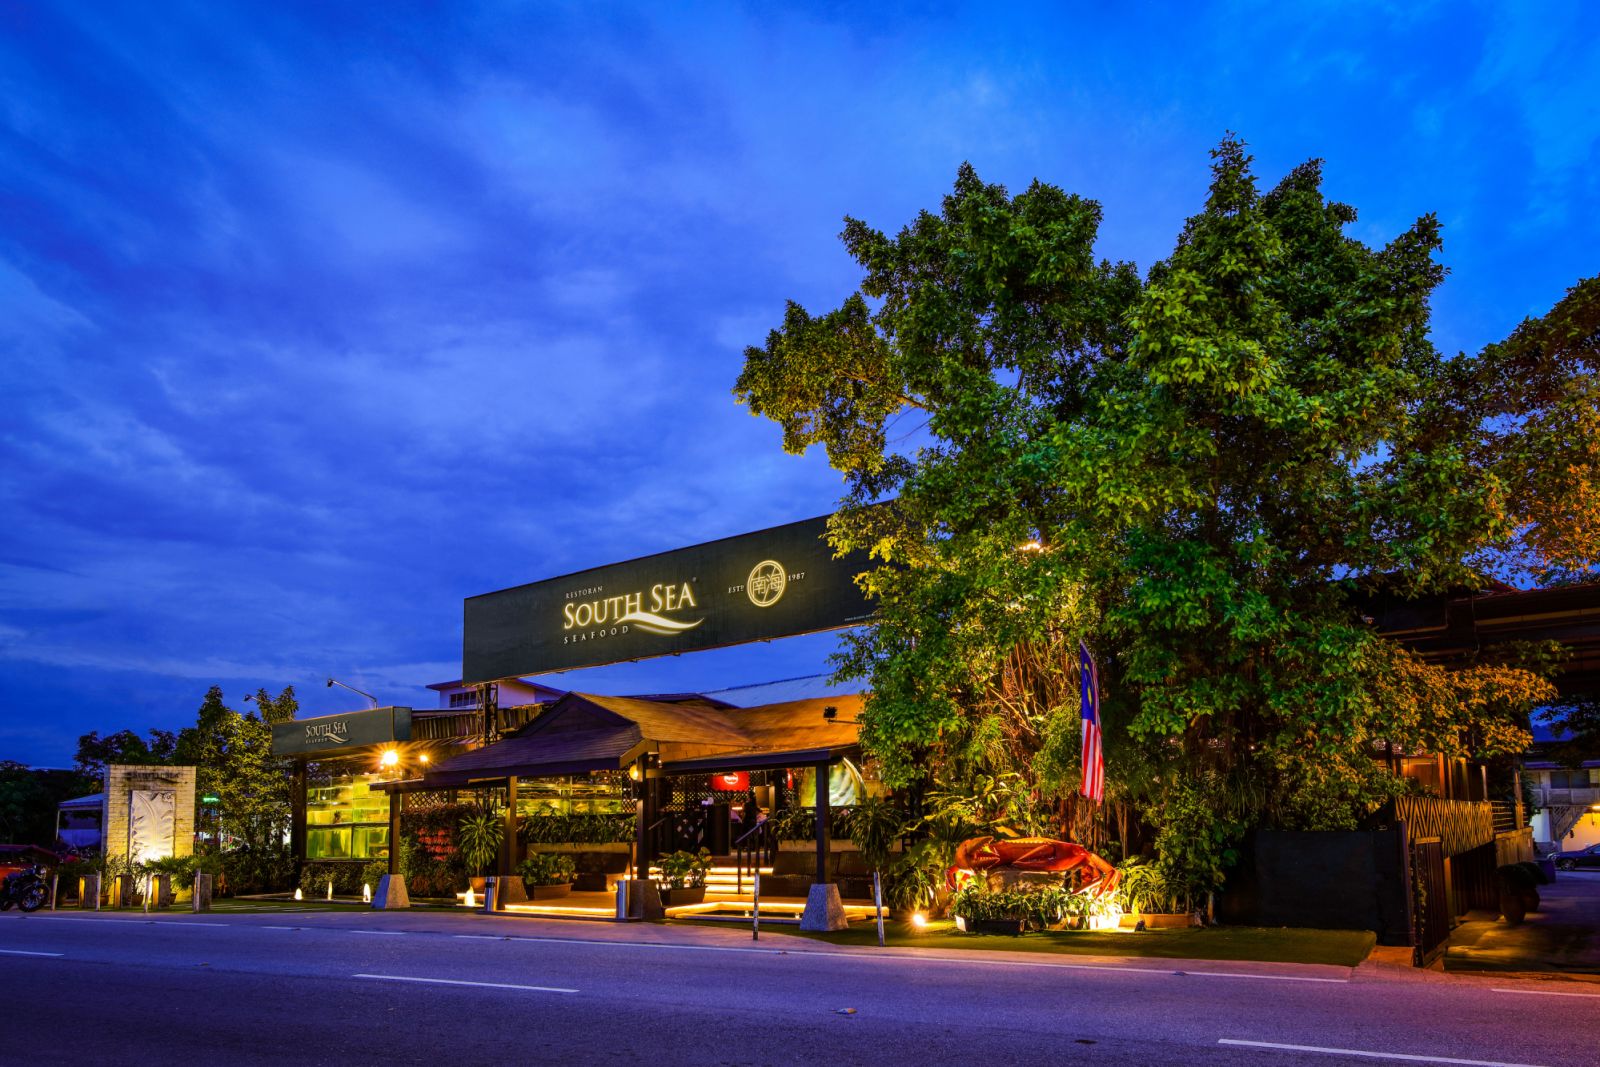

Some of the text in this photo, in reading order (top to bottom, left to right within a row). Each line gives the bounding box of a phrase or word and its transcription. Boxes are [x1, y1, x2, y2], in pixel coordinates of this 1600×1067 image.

[788, 572, 805, 582] 1987
[565, 585, 603, 599] RESTORAN
[563, 581, 697, 629] SOUTH SEA
[564, 625, 629, 645] SEAFOOD
[305, 721, 347, 738] SOUTH SEA
